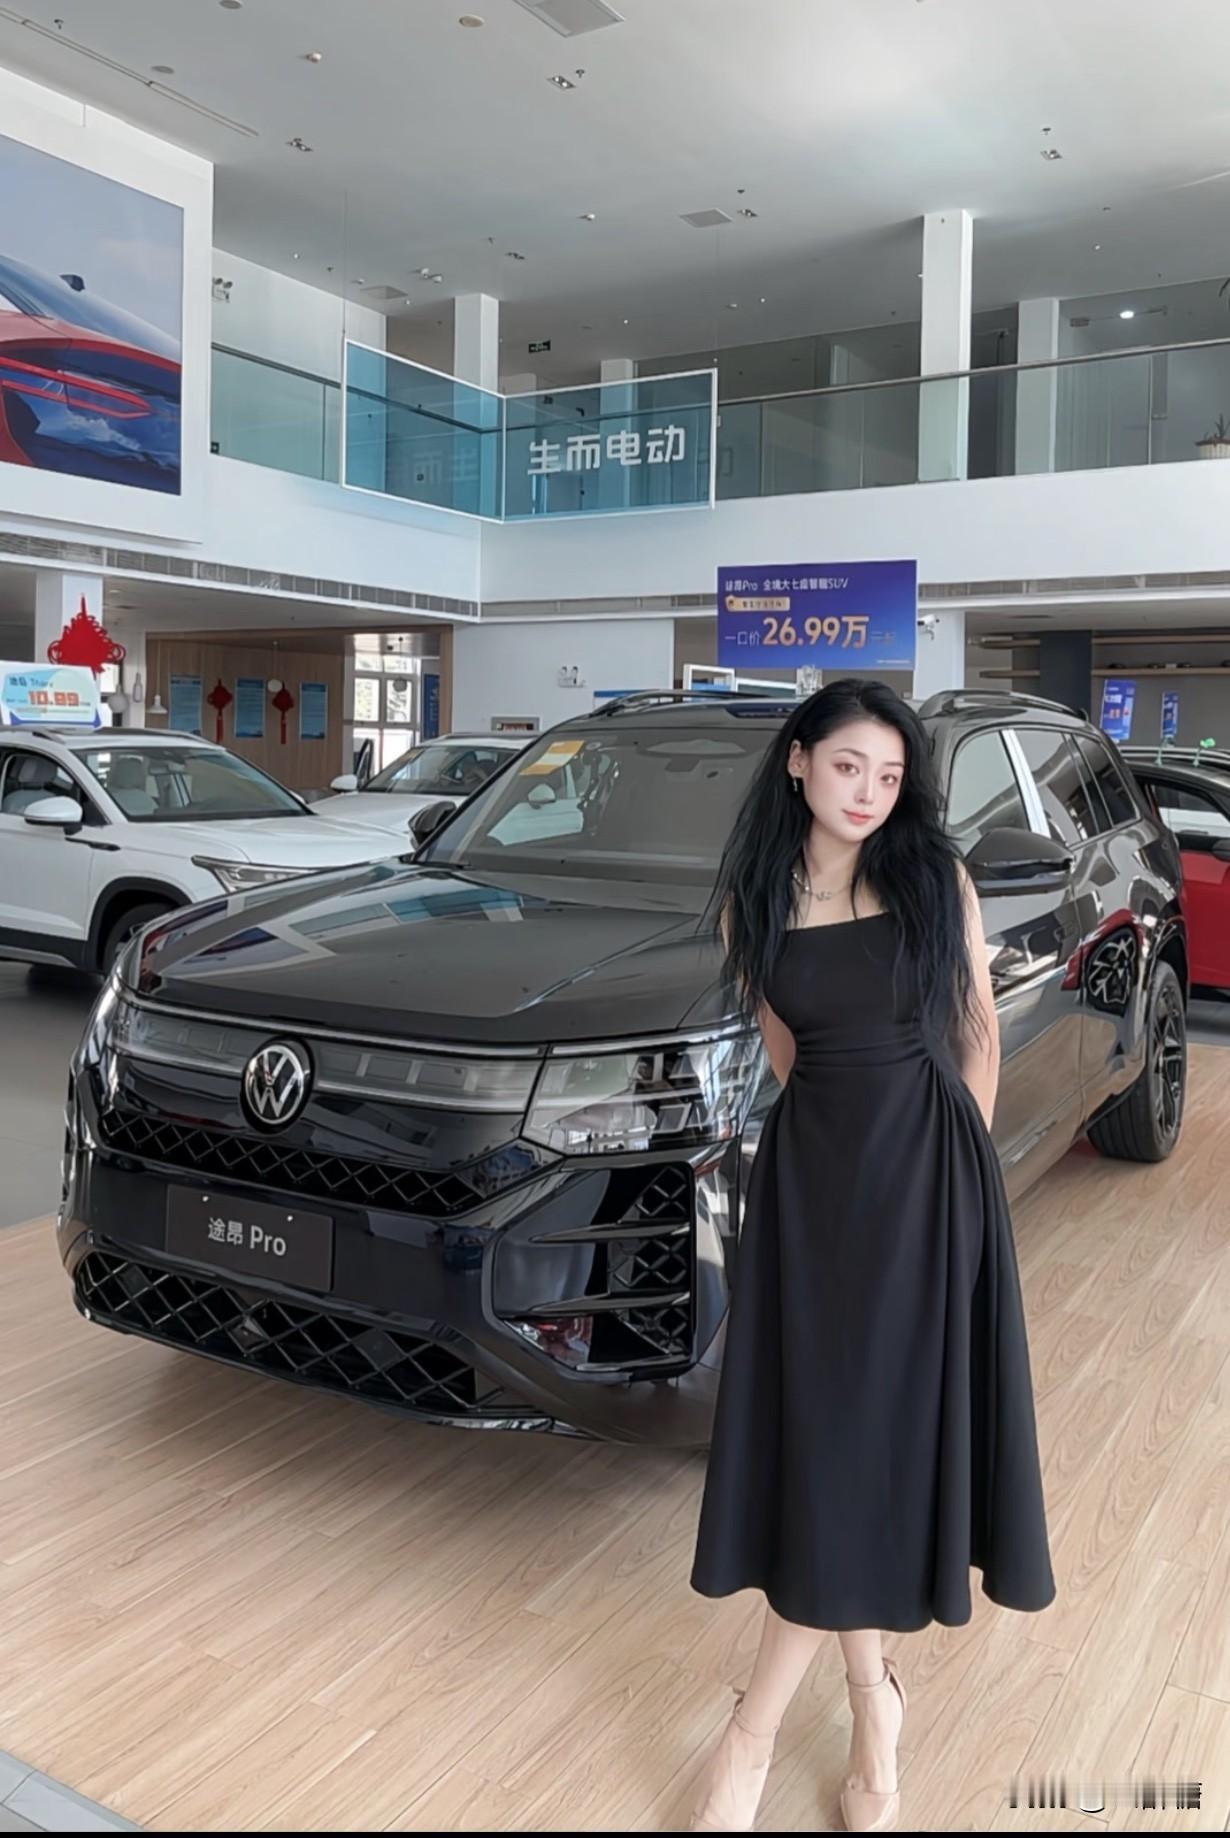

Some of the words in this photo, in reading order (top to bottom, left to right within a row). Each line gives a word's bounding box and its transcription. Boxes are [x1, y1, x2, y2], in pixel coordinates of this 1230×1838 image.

[527, 424, 686, 475] 生而电动
[725, 631, 760, 646] 一口价
[763, 616, 870, 648] 26.99万
[208, 1217, 243, 1245] 途昂
[250, 1225, 287, 1256] Pro
